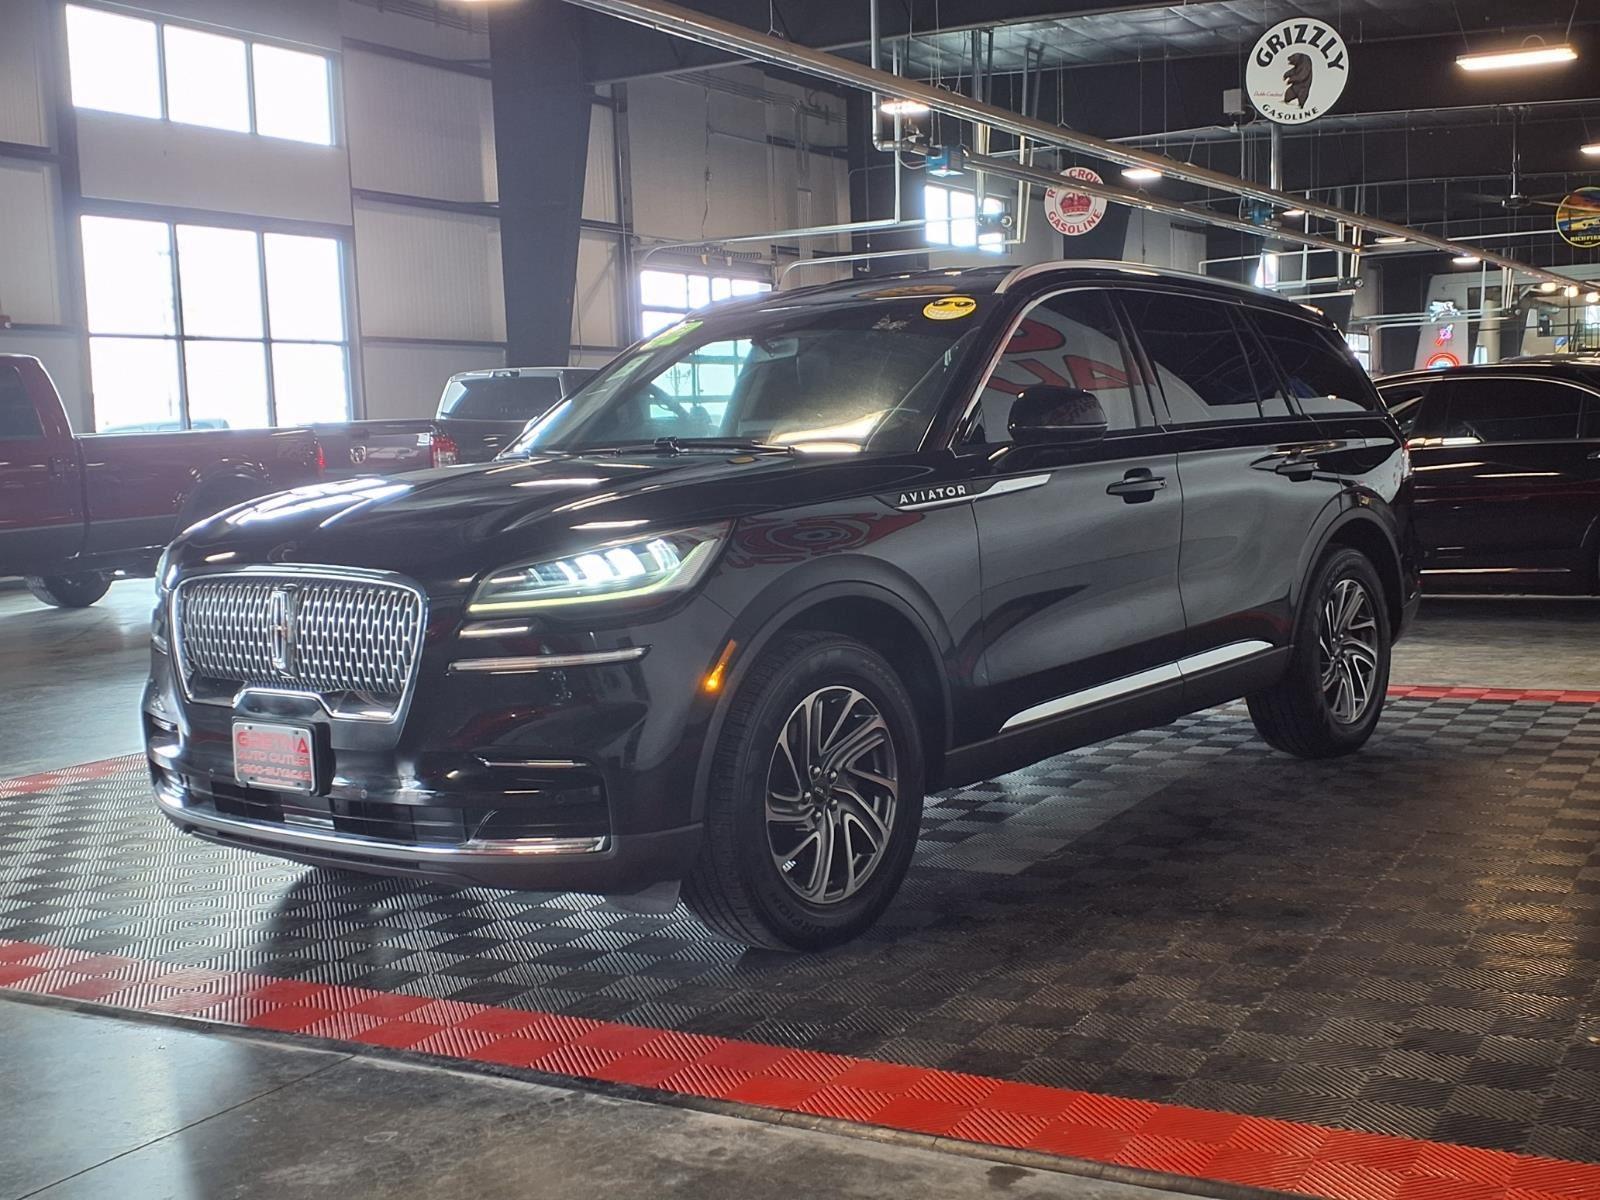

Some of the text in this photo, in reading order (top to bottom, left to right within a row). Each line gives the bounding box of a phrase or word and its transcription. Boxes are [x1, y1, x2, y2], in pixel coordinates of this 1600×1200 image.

[1256, 24, 1344, 71] GRIZZLY
[1262, 104, 1319, 120] GASOLINE
[1048, 209, 1102, 233] GASOLINE
[900, 485, 967, 504] AVIATOR
